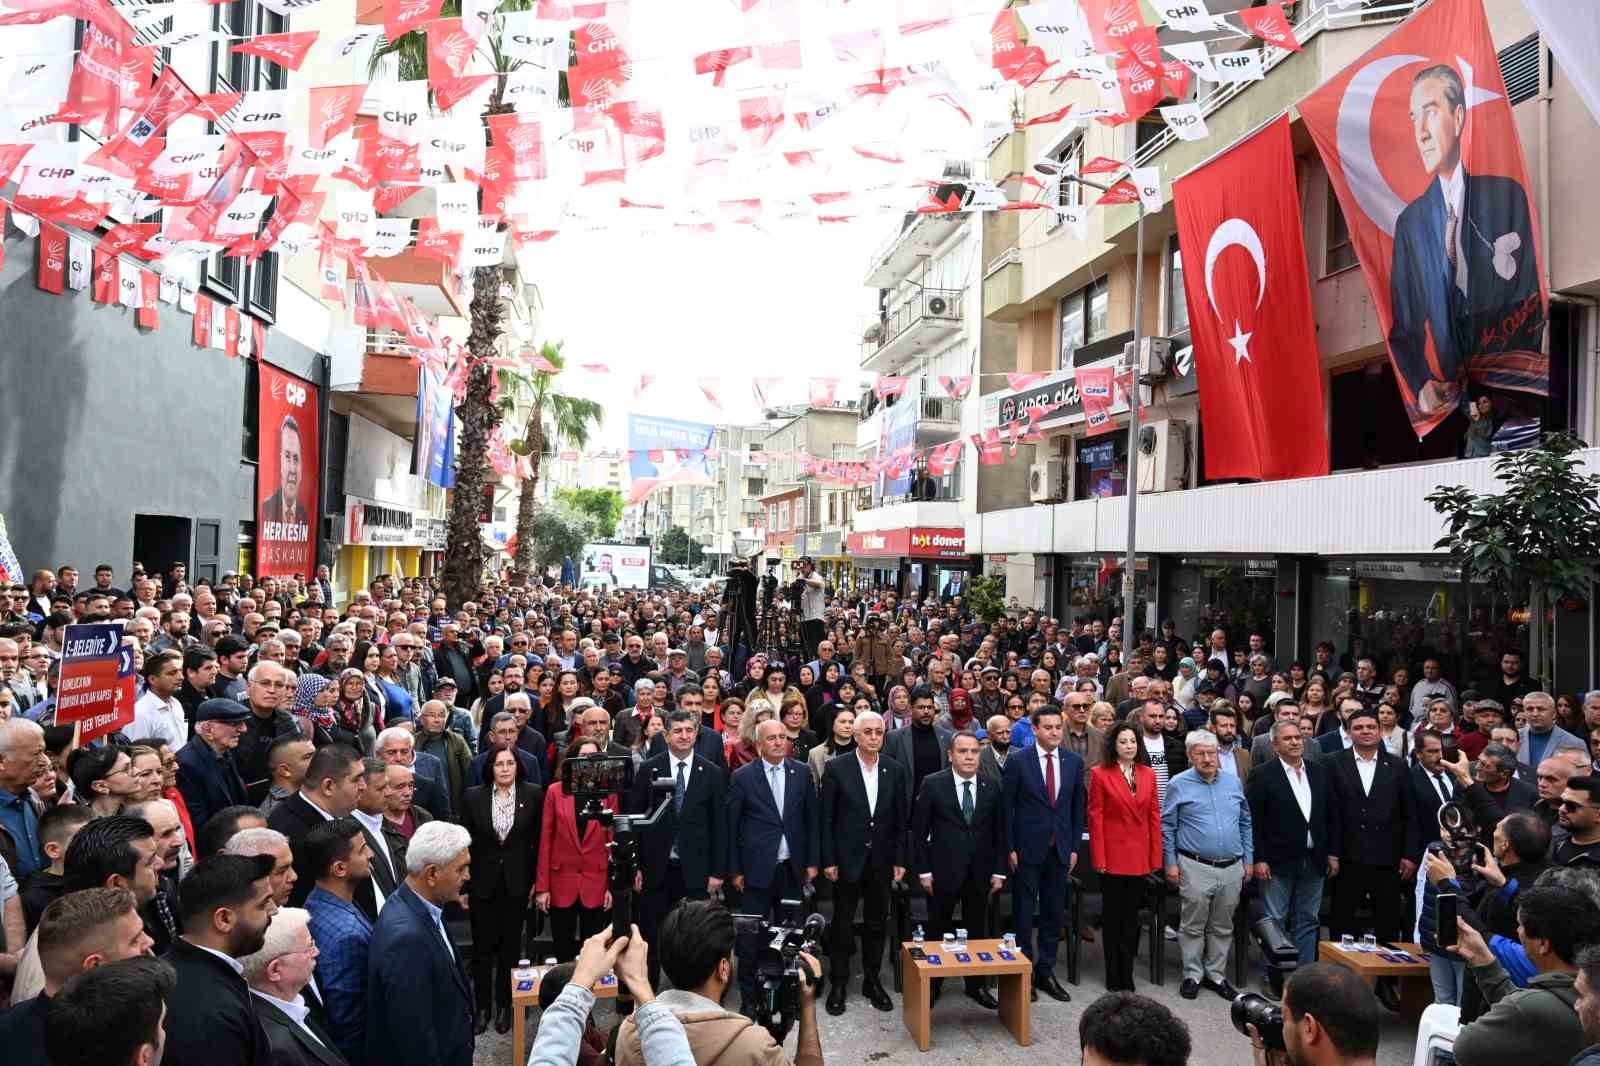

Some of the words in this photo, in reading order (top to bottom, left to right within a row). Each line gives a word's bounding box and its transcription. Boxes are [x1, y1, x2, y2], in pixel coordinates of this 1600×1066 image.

[1166, 6, 1198, 18] CHP
[1035, 24, 1070, 34] CHP
[1107, 20, 1138, 37] CHP
[512, 35, 555, 47] CHP
[588, 40, 619, 53] CHP
[1221, 57, 1251, 68] CHP
[1129, 78, 1155, 94] CHP
[242, 112, 282, 123] CHP
[383, 111, 418, 126] CHP
[170, 152, 205, 163] CHP
[301, 150, 337, 160] CHP
[38, 168, 75, 179] CHP
[419, 167, 443, 177] HP
[482, 173, 499, 182] HP
[478, 219, 496, 229] HP
[520, 231, 537, 241] CH
[424, 239, 449, 247] CHP
[47, 258, 63, 271] CHP
[285, 382, 307, 407] CHP
[1090, 411, 1107, 424] CHP
[263, 520, 308, 542] HERKESİN
[911, 534, 930, 550] hot
[259, 545, 308, 566] BAŞKANI
[65, 636, 106, 658] E-BELEDİYE
[82, 717, 94, 734] HER
